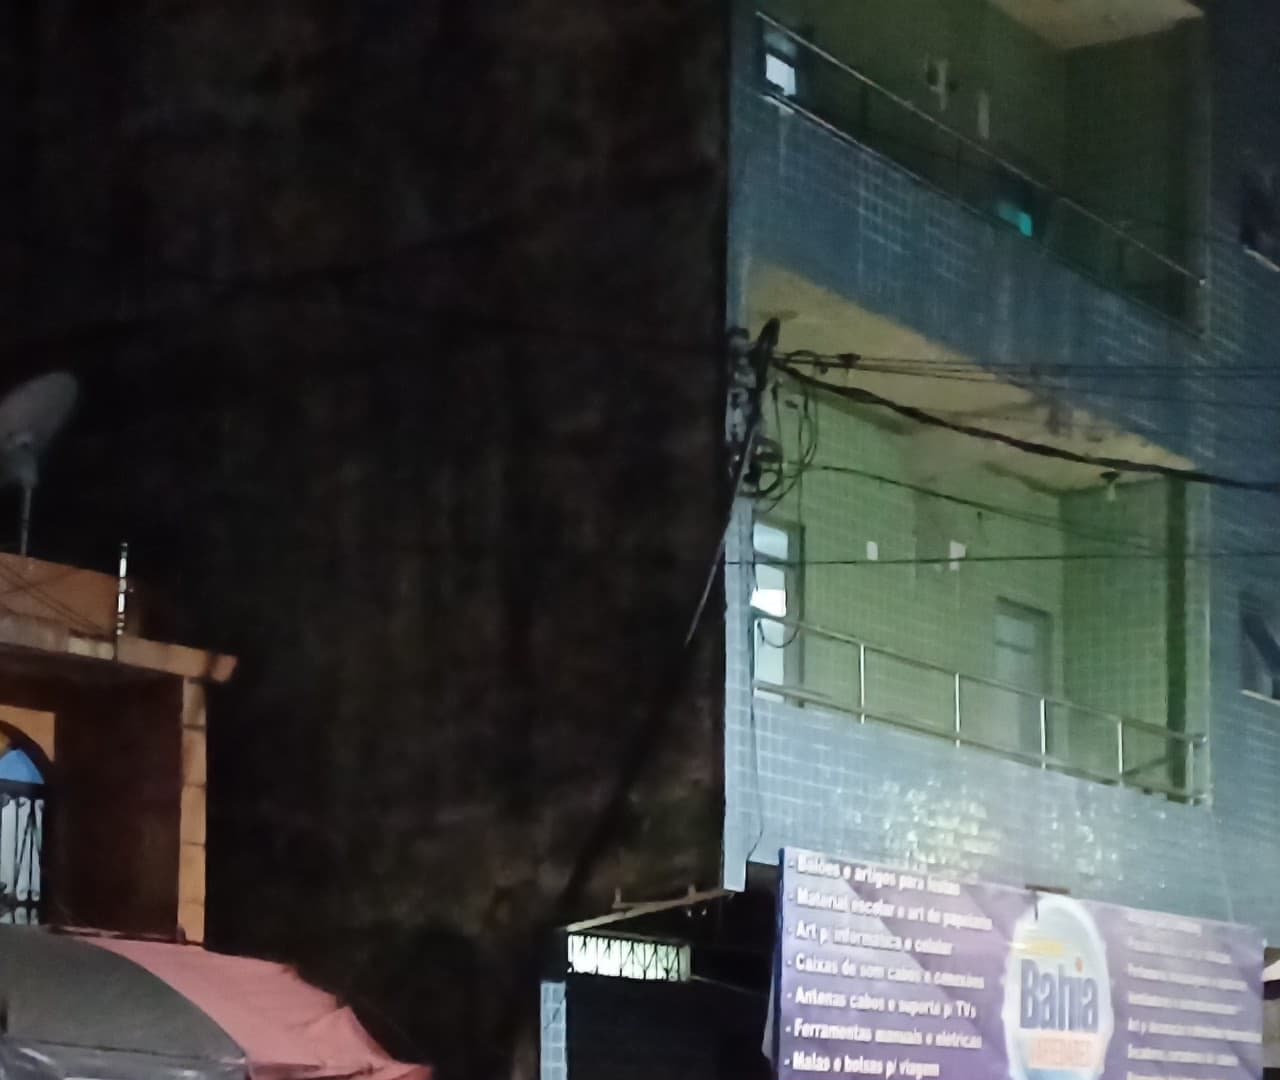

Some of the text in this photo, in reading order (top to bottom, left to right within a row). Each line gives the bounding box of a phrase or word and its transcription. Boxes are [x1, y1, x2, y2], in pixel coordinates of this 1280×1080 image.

[854, 865, 896, 889] artigos
[899, 874, 925, 890] para
[797, 887, 849, 912] Material
[851, 899, 895, 917] escolar
[796, 919, 818, 940] Art
[795, 952, 839, 976] Caixas
[794, 985, 847, 1008] Antenas
[849, 992, 885, 1012] cabos
[955, 999, 977, 1019] TVs
[1019, 957, 1099, 1034] Bahia
[793, 1017, 872, 1042] Ferramentas
[791, 1050, 831, 1073] Malas
[832, 1057, 843, 1073] e
[844, 1054, 883, 1075] bolsas
